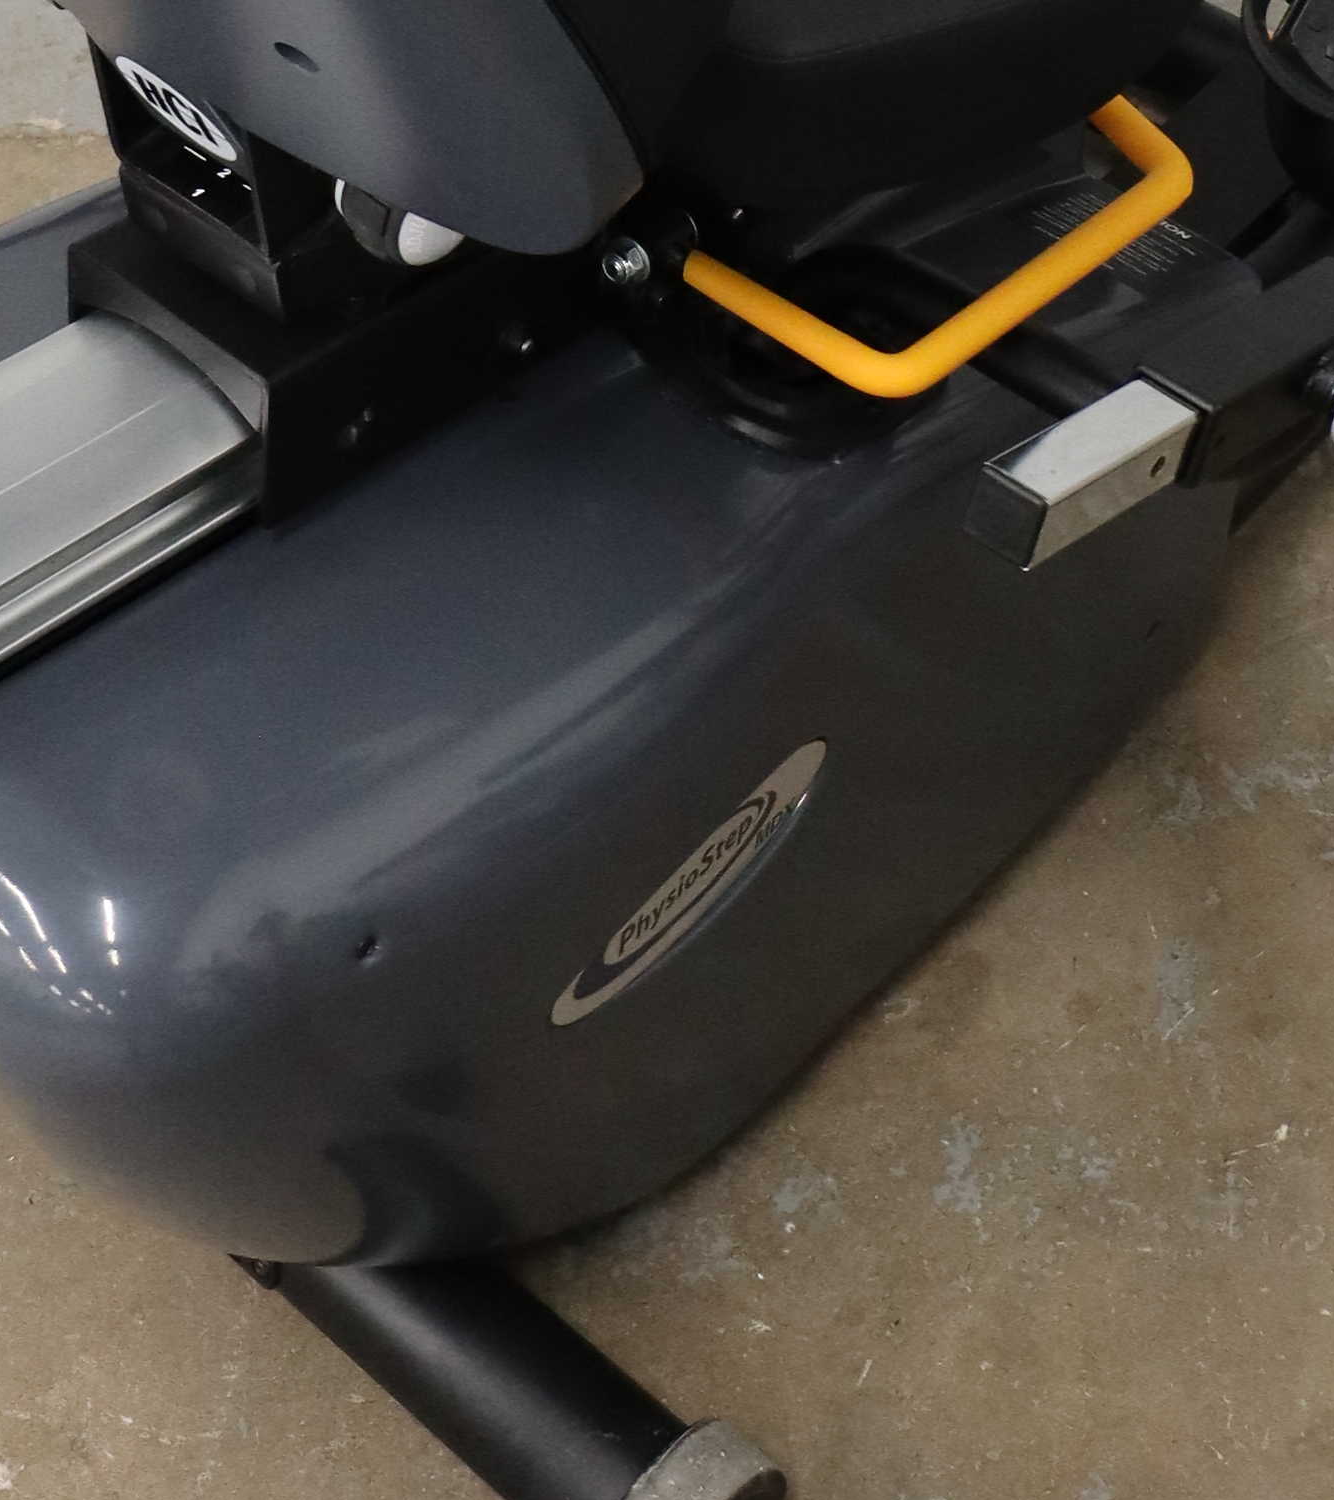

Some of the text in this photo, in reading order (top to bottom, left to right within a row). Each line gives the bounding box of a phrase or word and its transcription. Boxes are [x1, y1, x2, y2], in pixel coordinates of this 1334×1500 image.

[131, 71, 220, 149] HCI
[217, 168, 232, 179] 2
[617, 814, 754, 958] PhysioStep
